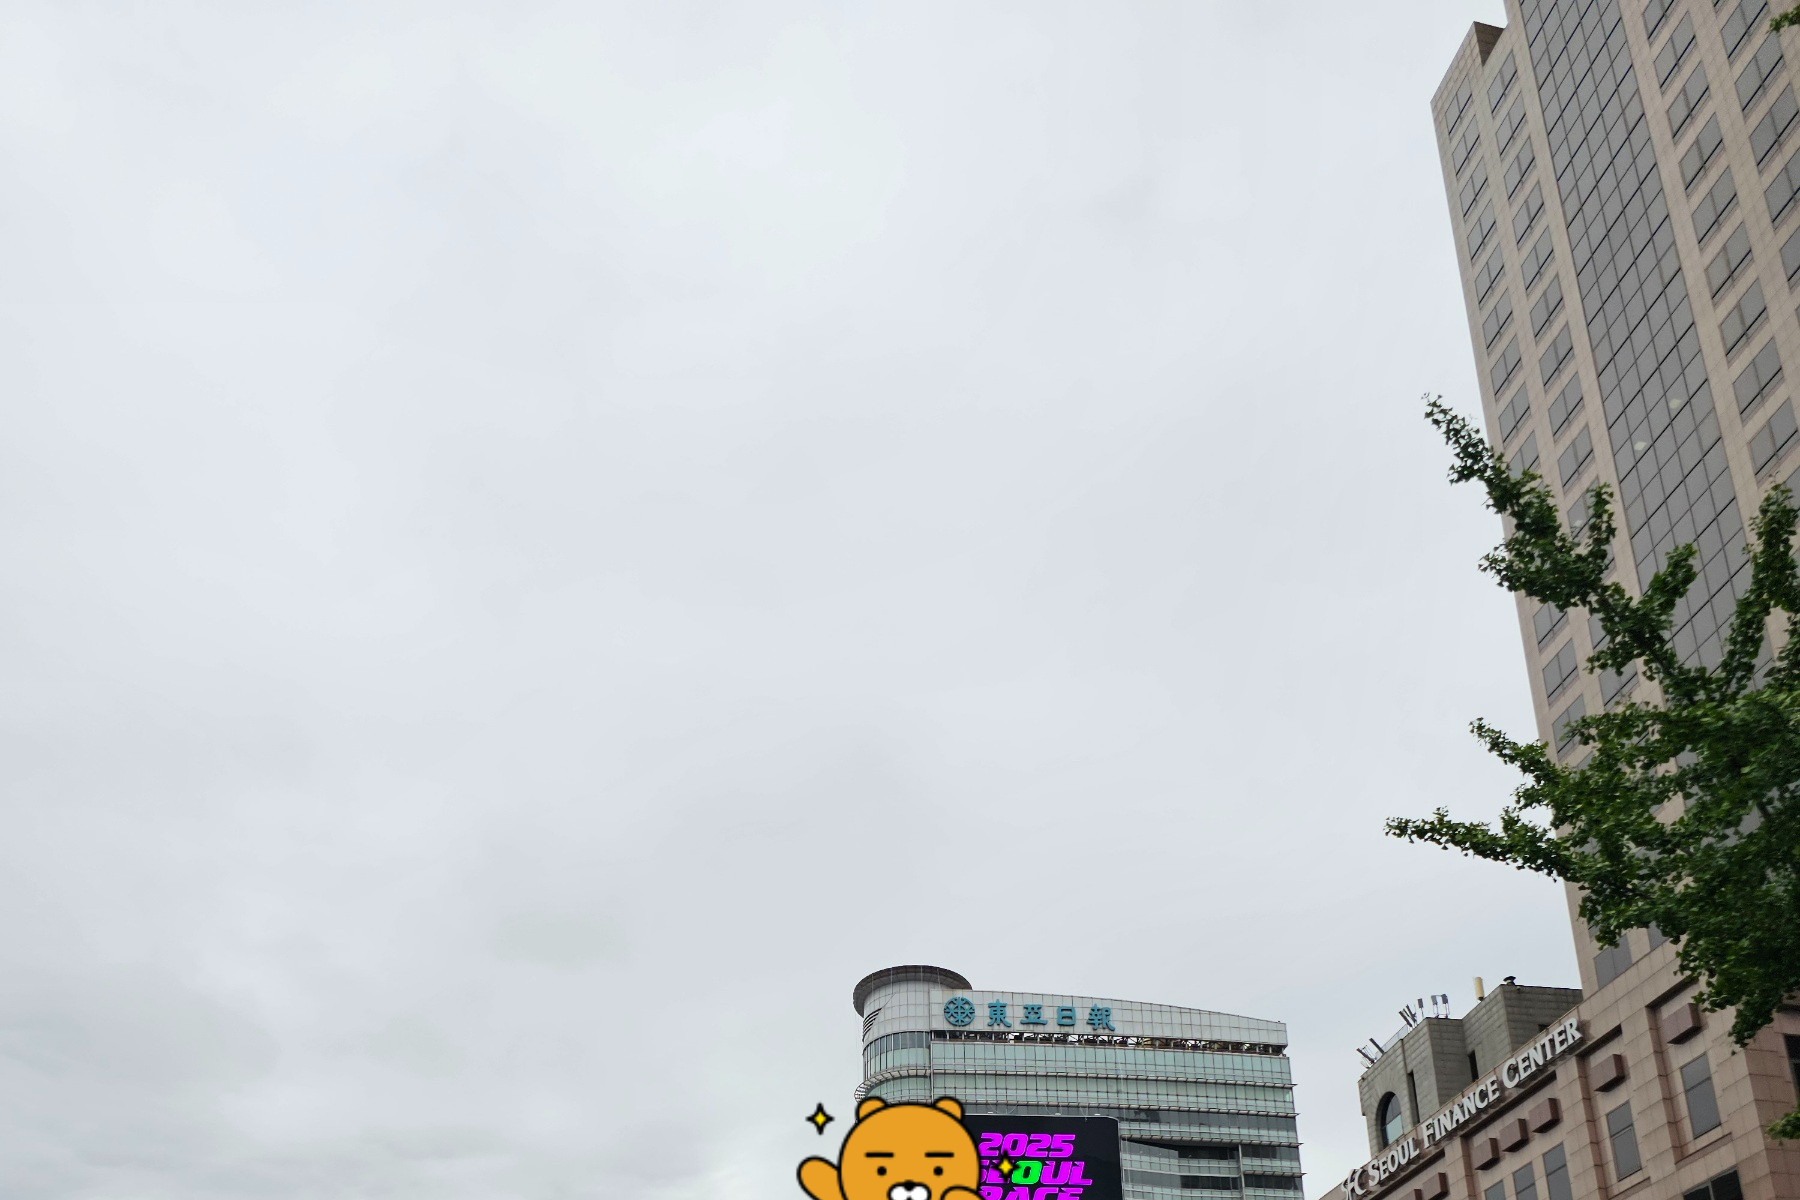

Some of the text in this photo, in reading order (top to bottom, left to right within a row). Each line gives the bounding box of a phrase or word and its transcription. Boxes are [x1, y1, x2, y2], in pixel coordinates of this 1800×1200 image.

[987, 998, 1116, 1031] 東亞日報
[1367, 1136, 1421, 1188] SEOUL
[1420, 1074, 1501, 1147] FINANCE
[1501, 1017, 1584, 1090] CENTER
[978, 1132, 1076, 1158] 2025
